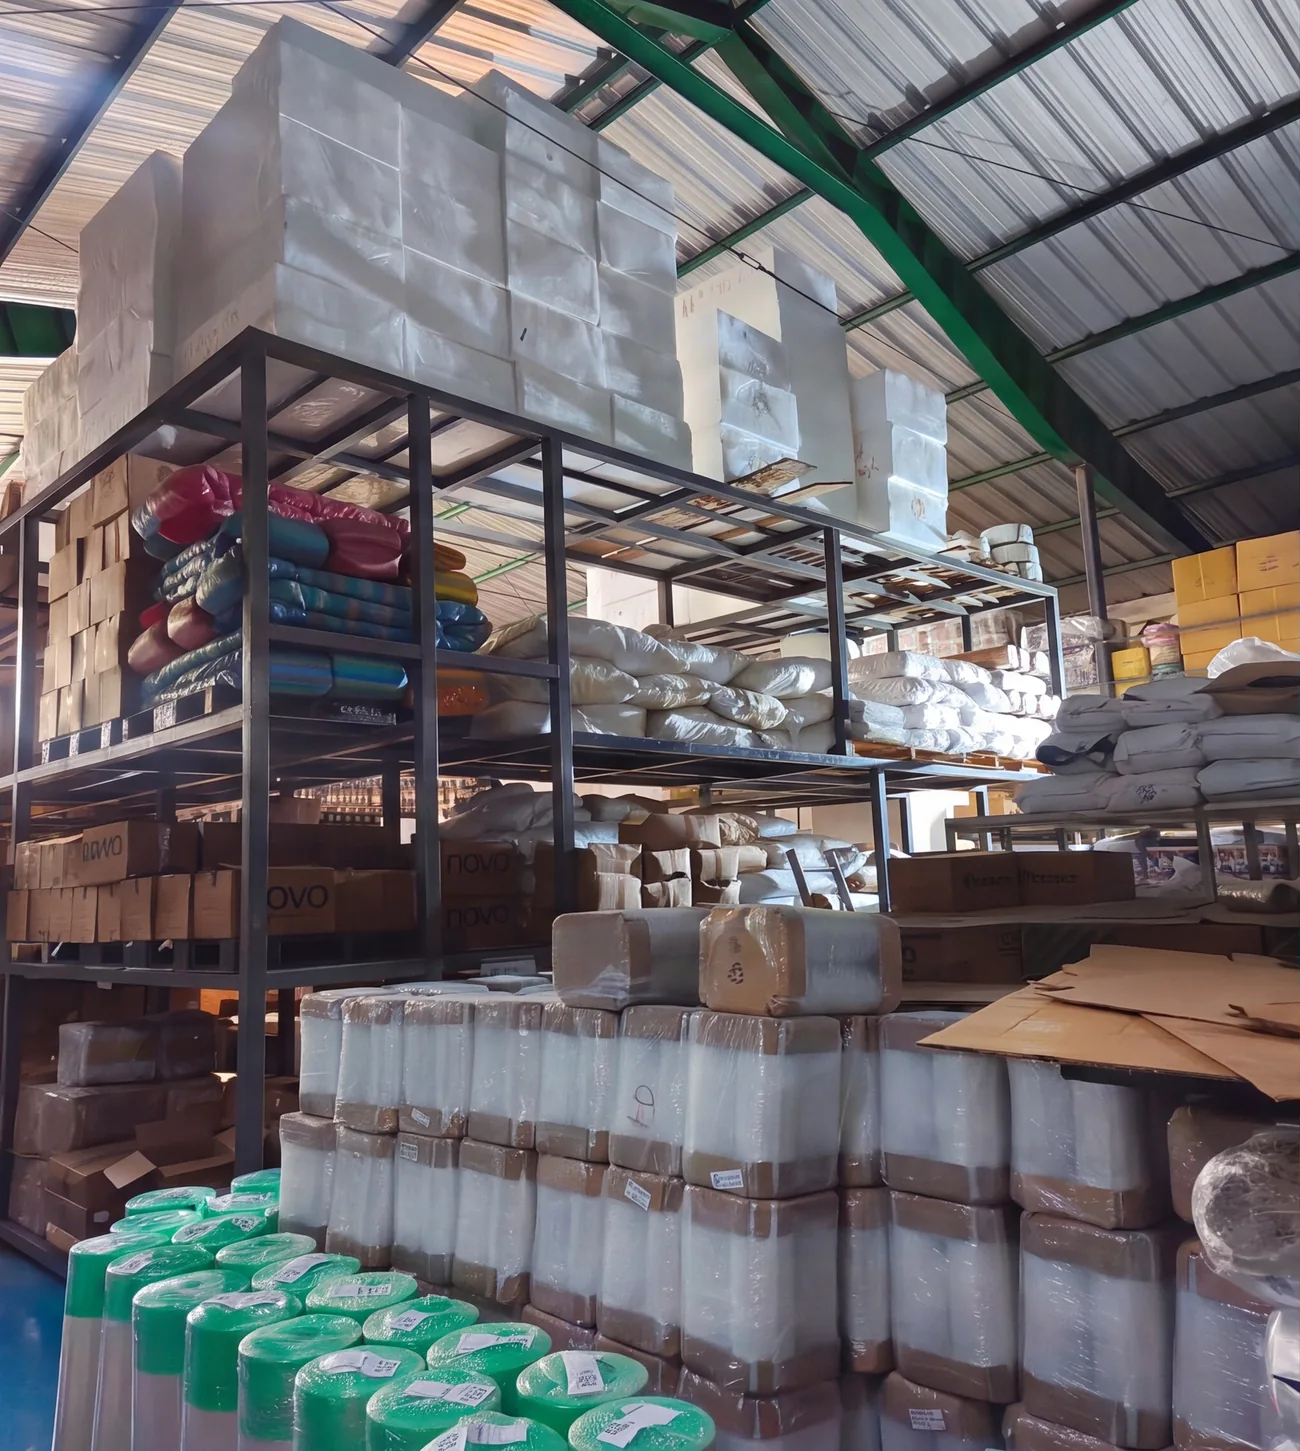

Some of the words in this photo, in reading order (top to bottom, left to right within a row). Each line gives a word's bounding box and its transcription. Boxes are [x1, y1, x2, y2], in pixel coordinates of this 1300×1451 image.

[446, 852, 510, 874] novo
[267, 884, 328, 910] ovo
[446, 904, 510, 929] novo
